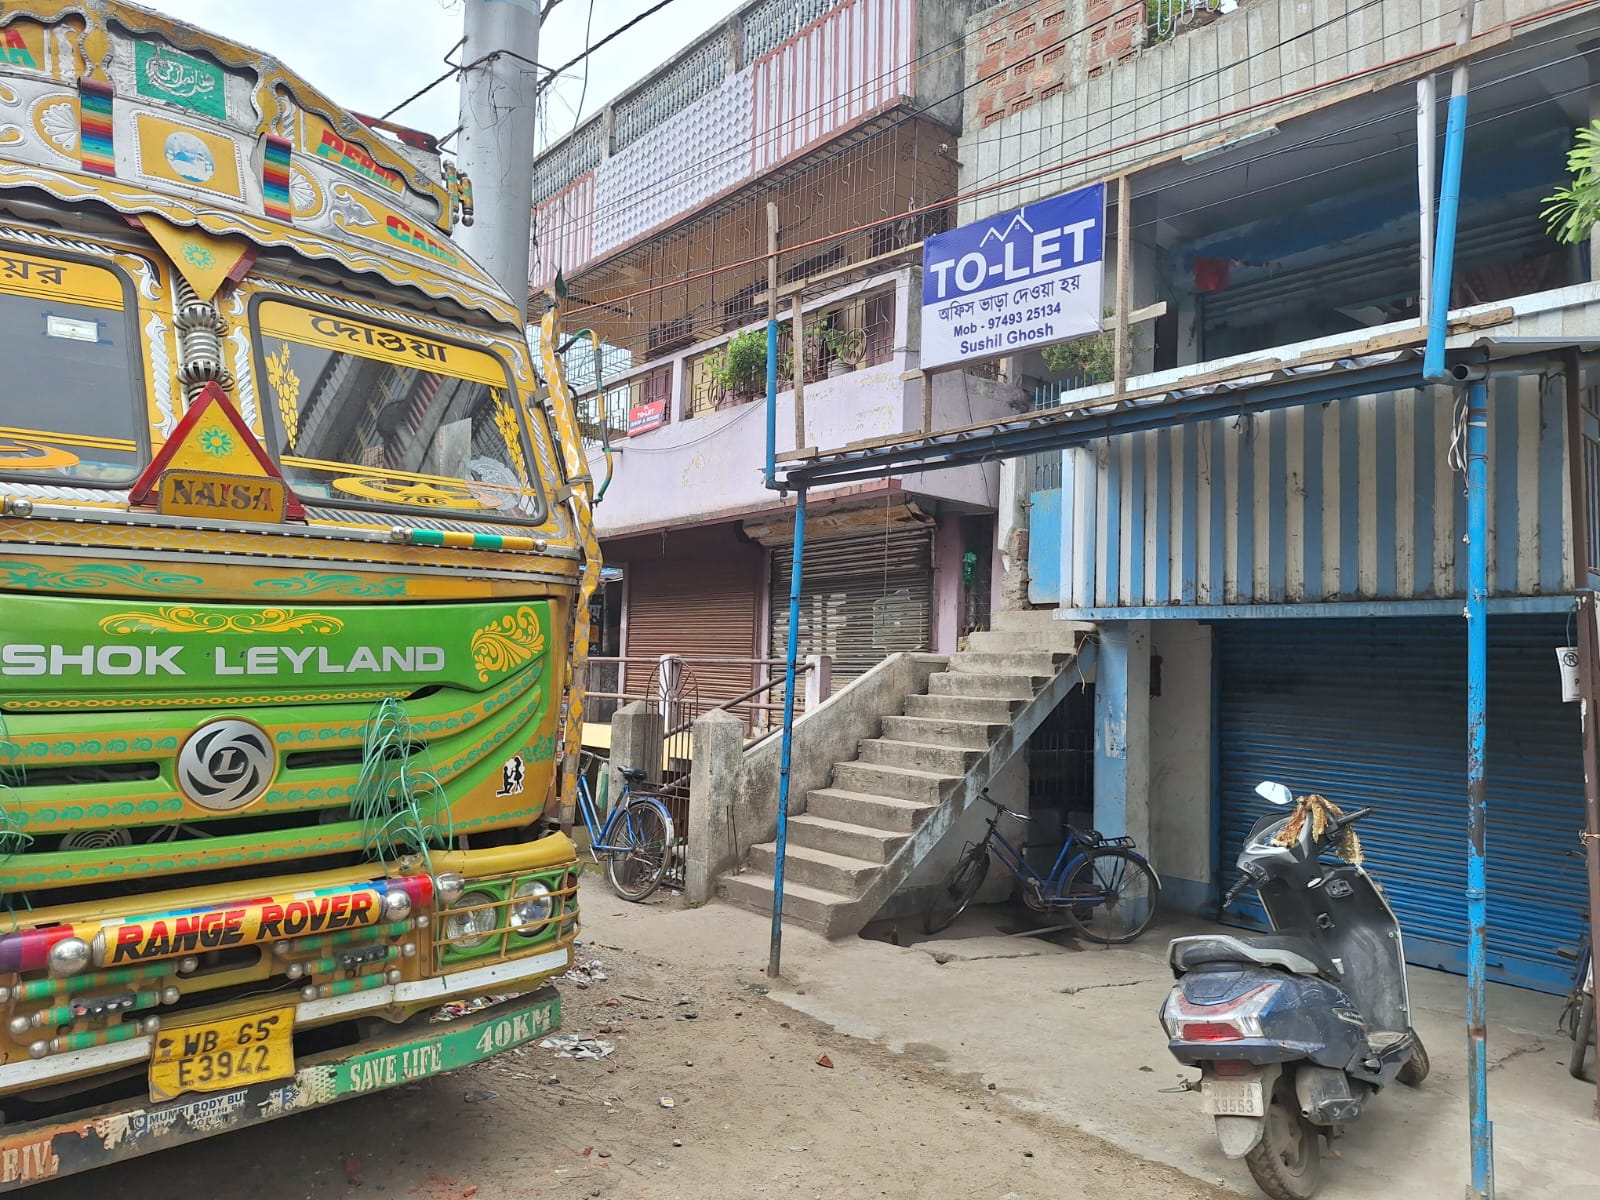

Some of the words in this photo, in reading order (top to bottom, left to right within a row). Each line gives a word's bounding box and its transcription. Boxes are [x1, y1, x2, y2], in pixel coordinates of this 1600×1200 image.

[929, 217, 1096, 299] TO-LET
[938, 300, 975, 323] অফিস
[978, 292, 1009, 314] ভাড়া
[1013, 281, 1054, 306] দেওয়া
[1059, 274, 1081, 294] হয়
[953, 322, 977, 338] Mob
[988, 312, 1023, 331] 97493
[1026, 302, 1061, 322] 25134
[309, 314, 447, 362] দোওয়া
[960, 332, 1002, 355] Sushil
[1007, 323, 1054, 345] Ghosh
[171, 479, 275, 512] NAISA
[2, 644, 187, 676] SHOK
[215, 646, 445, 675] LEYLAND
[112, 908, 246, 963] RANGE
[256, 892, 374, 940] ROVER
[183, 1030, 218, 1057] WB
[237, 1018, 273, 1045] 65
[476, 1005, 552, 1054] 40KM
[350, 1055, 398, 1093] SAVE
[402, 1042, 442, 1080] LIFE
